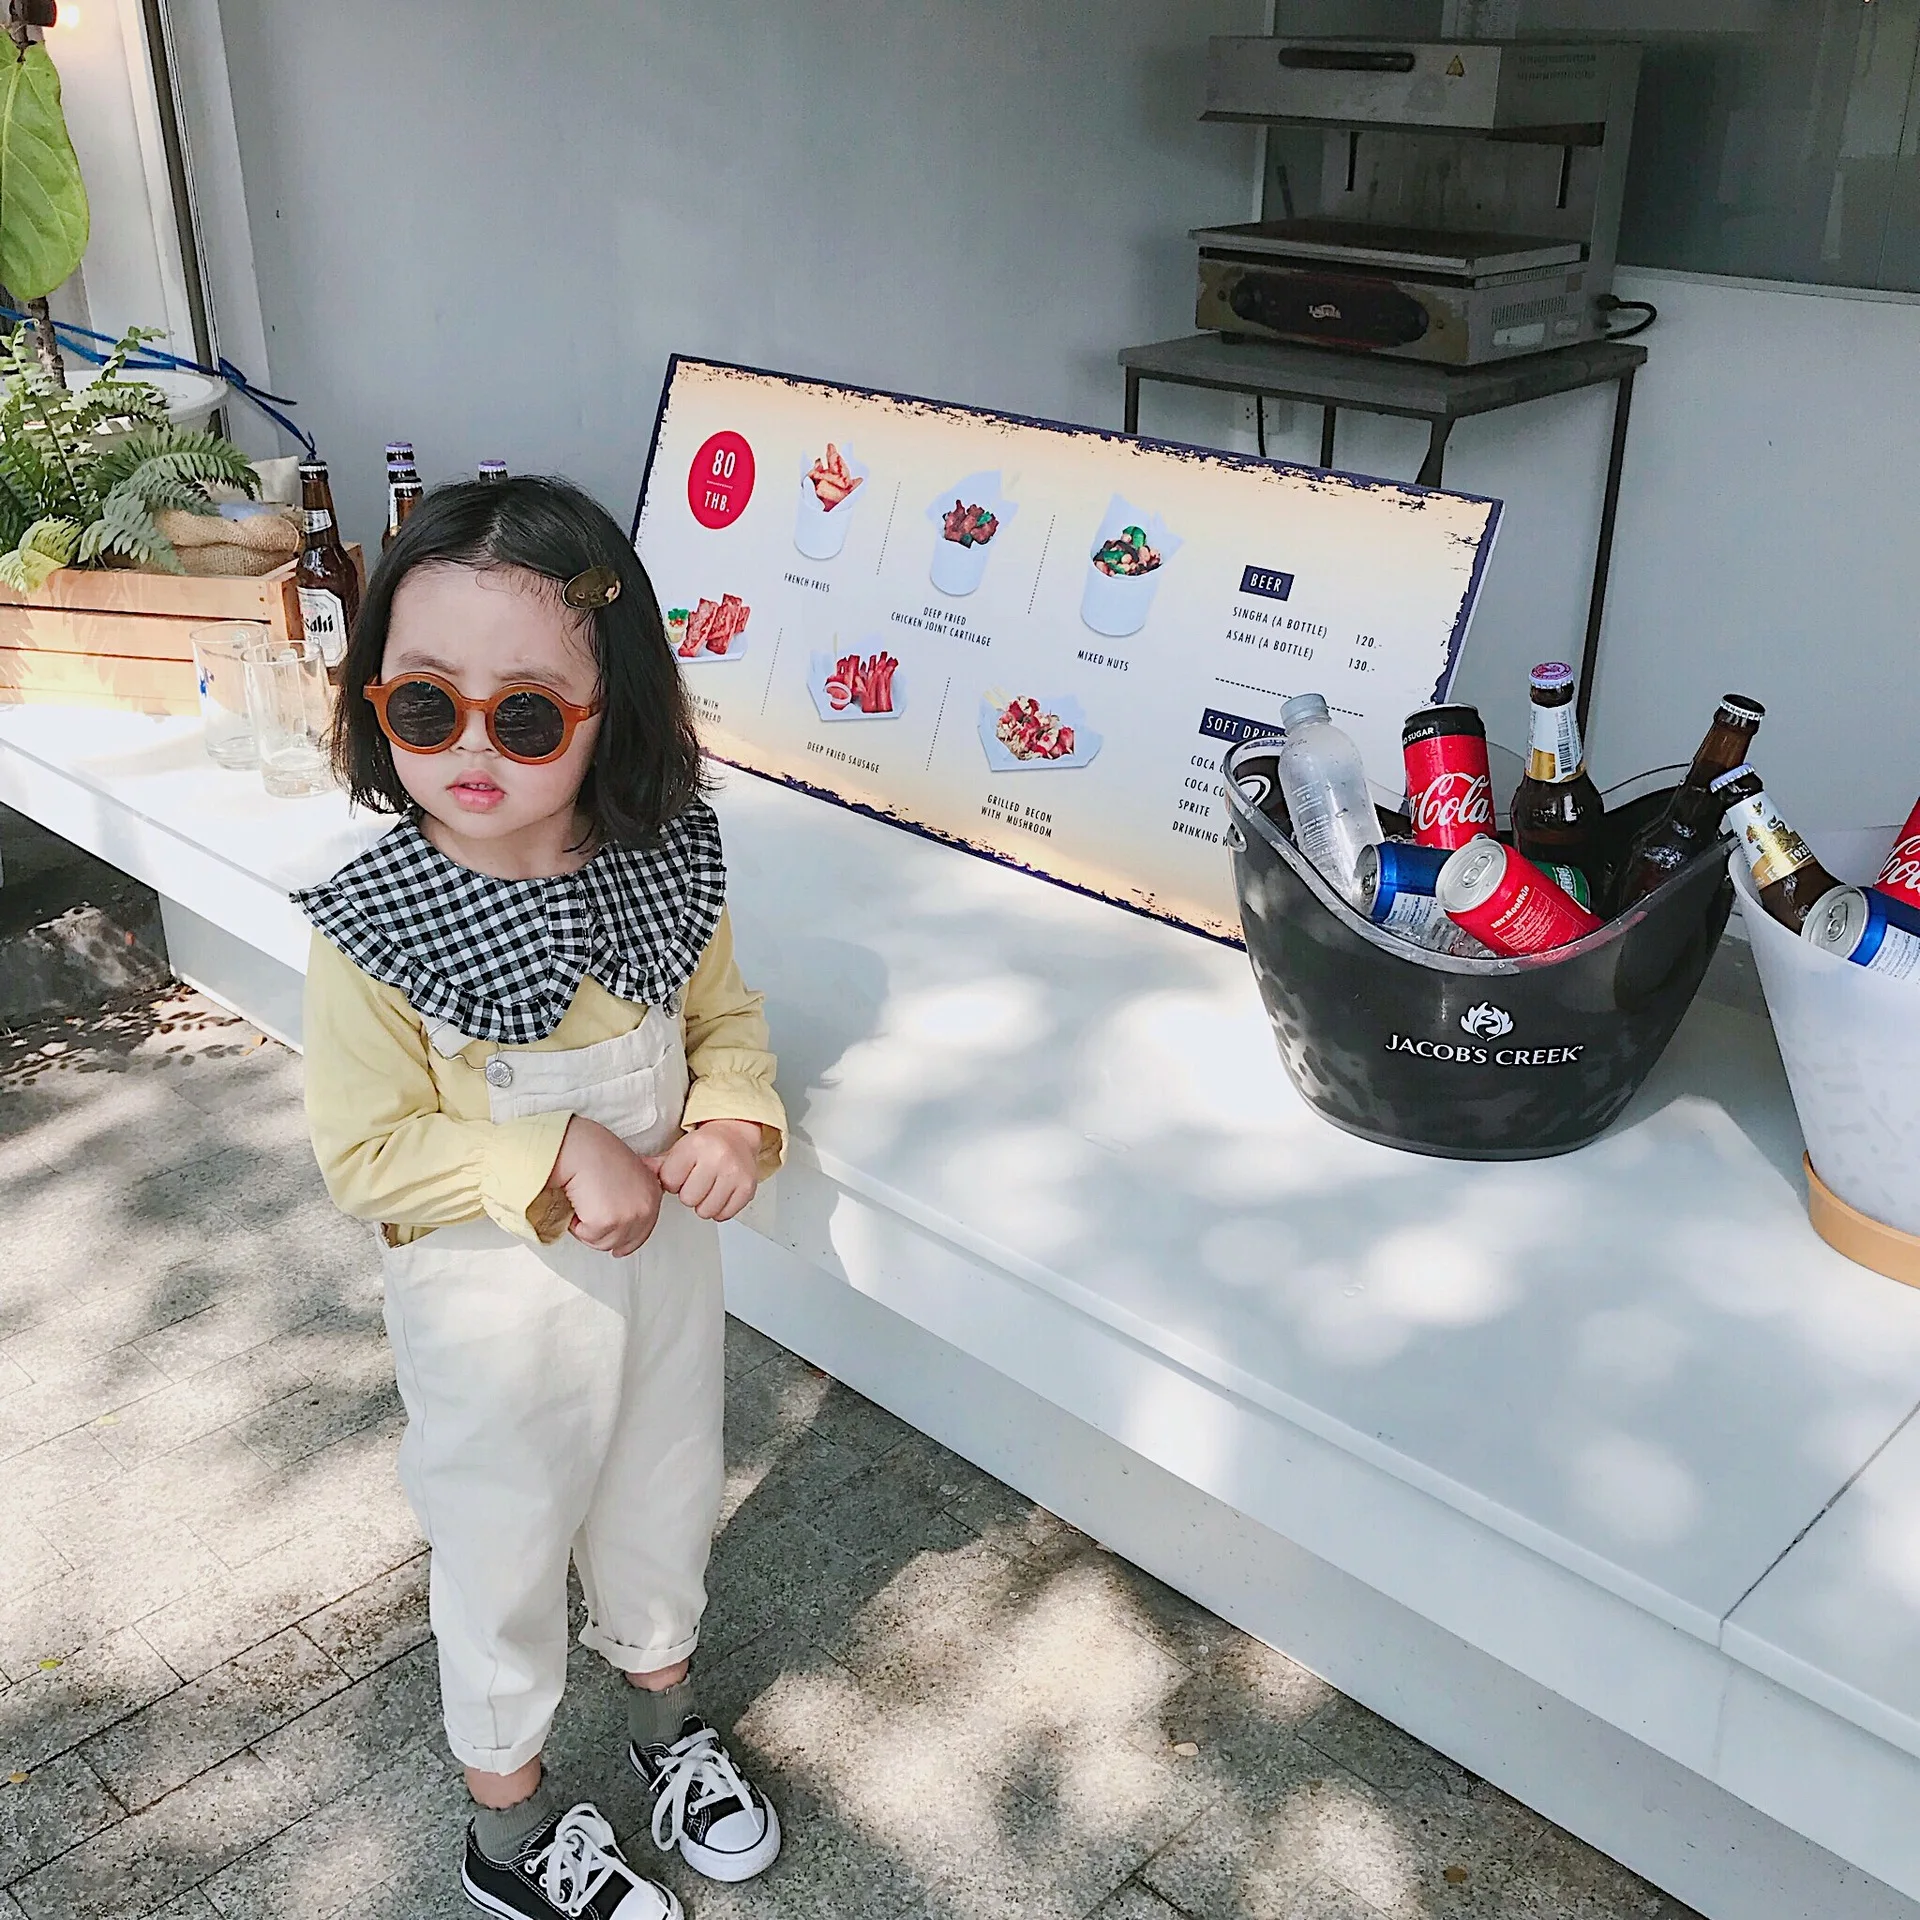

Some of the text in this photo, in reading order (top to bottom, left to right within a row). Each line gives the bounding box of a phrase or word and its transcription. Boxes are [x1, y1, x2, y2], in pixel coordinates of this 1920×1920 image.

[712, 449, 736, 478] 80
[704, 491, 730, 513] THB.
[784, 572, 830, 593] FRENCH FRIES
[1250, 573, 1283, 593] BEER
[923, 606, 967, 626] DEEP FRIED
[890, 611, 992, 647] CHICKEN JOINT CARTILAGE
[1232, 606, 1383, 649] SINGHA (A BOTTLE) 120.-
[1077, 649, 1130, 672] MIXED NUTS
[1225, 629, 1375, 673] ASAHI (A BOTTLE) 130.-
[703, 698, 720, 710] WITH
[1206, 715, 1239, 736] SOFT
[1407, 727, 1435, 742] SUGAR
[806, 740, 880, 774] DEEP FRIED SAUSAGE
[1190, 755, 1215, 771] COCA
[1184, 777, 1225, 798] COCA CO
[987, 794, 1052, 823] GRILLED BECON
[1178, 799, 1210, 818] SPRITE
[980, 806, 1052, 838] WITH MUSHROOM
[1172, 820, 1219, 844] DRINKING
[1385, 1034, 1579, 1066] JACOB'S CREEK
